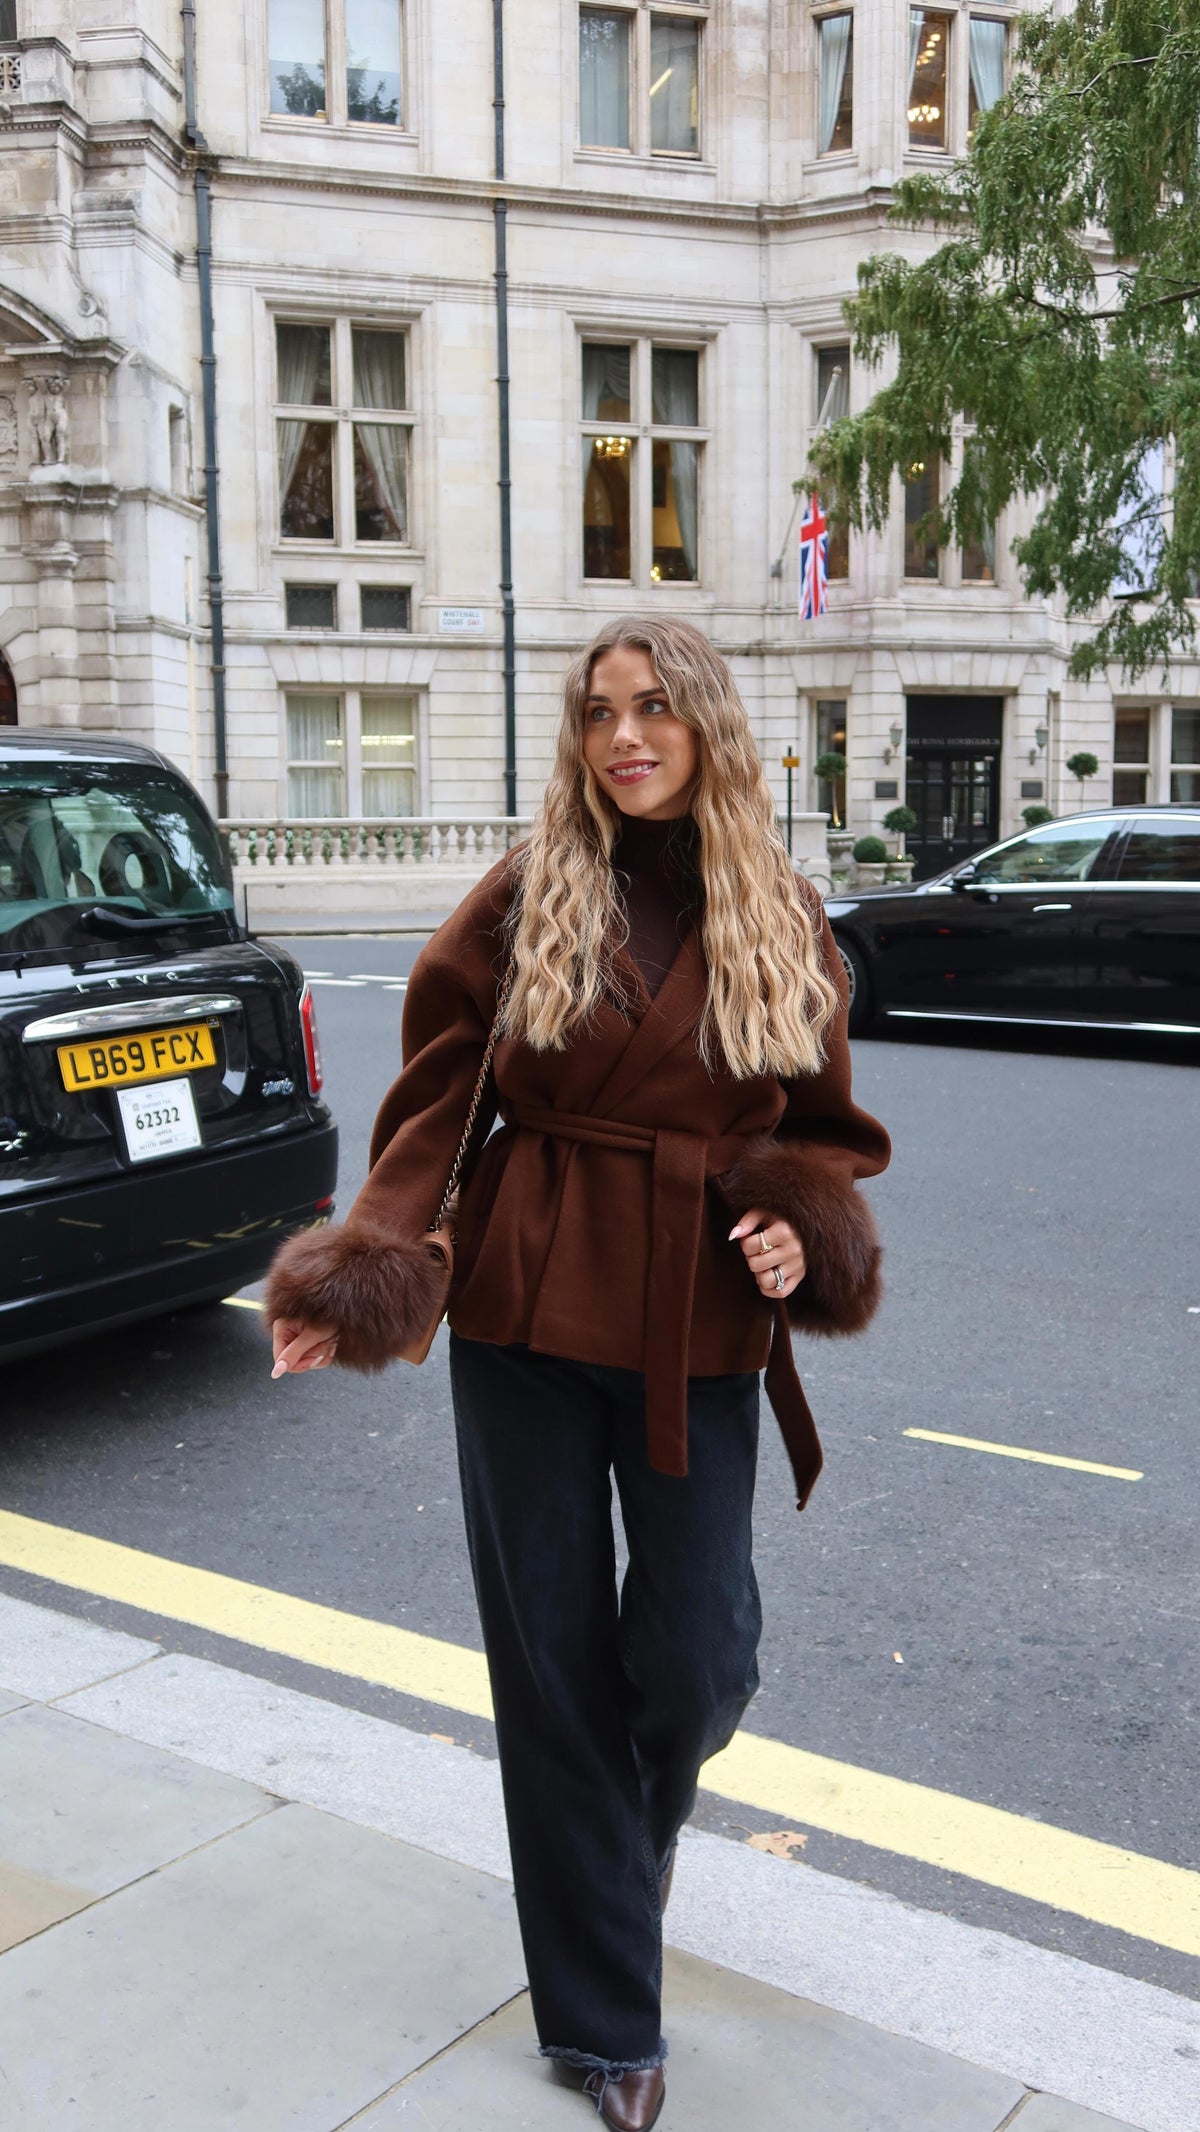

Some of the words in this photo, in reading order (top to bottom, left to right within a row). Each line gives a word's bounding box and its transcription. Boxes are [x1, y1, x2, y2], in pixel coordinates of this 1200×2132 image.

[442, 618, 464, 626] COURT
[467, 618, 480, 626] SW1
[443, 610, 480, 618] WHITEHALL
[76, 971, 179, 994] LEVC
[69, 1041, 146, 1083] LB69
[151, 1031, 204, 1069] FCX
[136, 1107, 181, 1130] 62322
